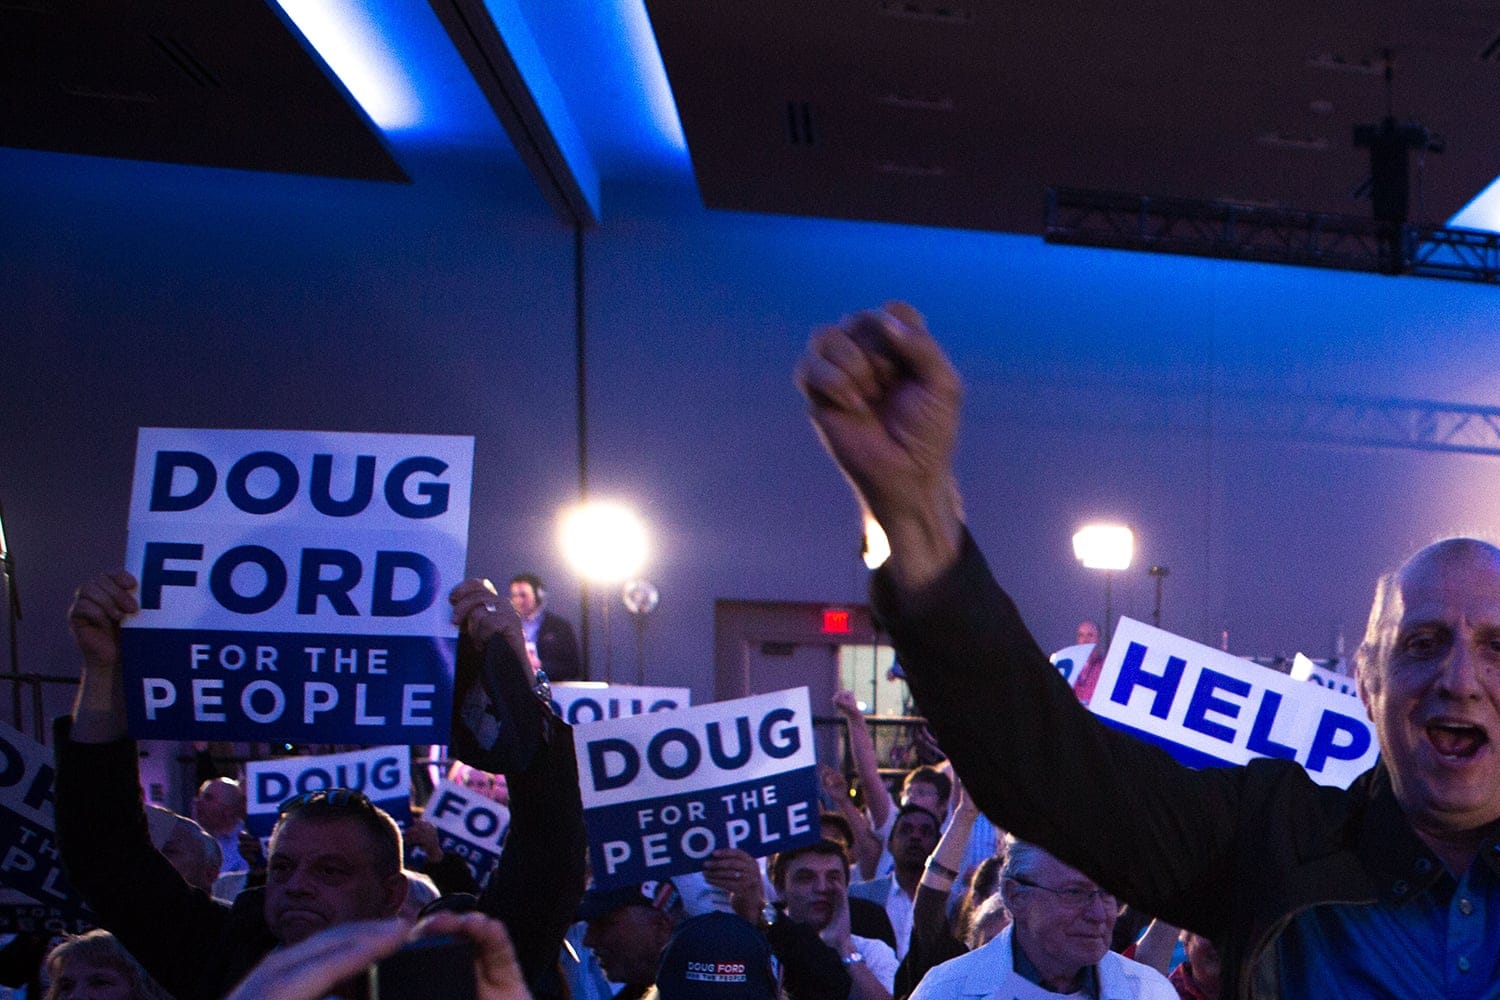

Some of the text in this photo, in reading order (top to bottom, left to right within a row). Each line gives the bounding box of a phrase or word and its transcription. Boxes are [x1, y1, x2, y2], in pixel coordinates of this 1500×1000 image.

[149, 451, 450, 519] DOUG
[141, 542, 441, 617] FORD
[190, 643, 389, 675] FOR THE
[141, 677, 435, 726] PEOPLE
[1110, 641, 1371, 773] HELP
[587, 708, 801, 791] DOUG
[256, 757, 401, 804] DOUG
[638, 785, 777, 829] FOR THE
[433, 791, 508, 846] FO
[603, 802, 810, 875] PEOPLE
[688, 961, 746, 973] DOUG FORD
